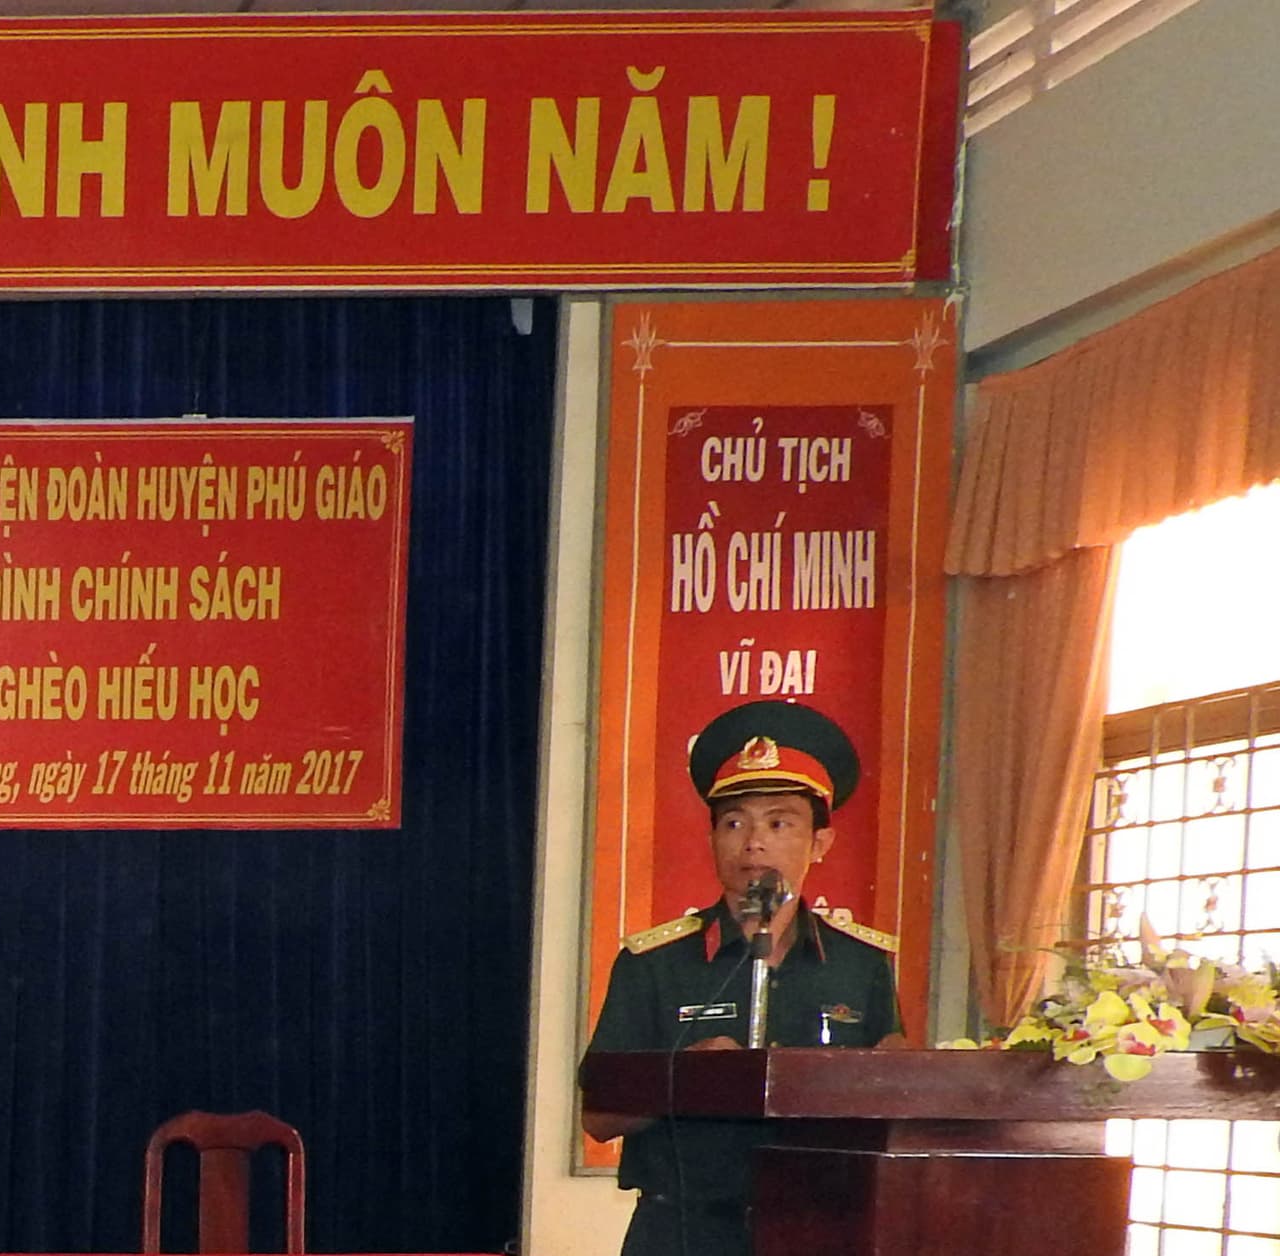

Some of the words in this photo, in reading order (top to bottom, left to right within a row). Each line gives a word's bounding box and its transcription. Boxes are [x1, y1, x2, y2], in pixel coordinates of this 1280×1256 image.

[168, 70, 486, 218] MUÔN
[526, 66, 770, 213] NĂM
[47, 452, 128, 521] ĐOÀN
[137, 454, 237, 537] HUYỆN
[247, 451, 306, 521] PHÚ
[316, 450, 387, 520] GIÁO
[702, 417, 766, 481] CHỦ
[778, 437, 851, 493] TỊCH
[71, 551, 178, 621] CHÍNH
[189, 551, 280, 621] SÁCH
[672, 501, 720, 612] HỒ
[728, 512, 785, 612] CHÍ
[793, 531, 875, 610] MINH
[98, 643, 178, 720] HIẾU
[189, 665, 259, 736] HỌC
[720, 638, 754, 694] VĨ
[760, 650, 816, 703] ĐẠI
[28, 751, 87, 803] ngày
[92, 751, 127, 794] 17
[130, 751, 198, 803] tháng
[203, 751, 234, 794] 11
[240, 754, 292, 794] năm
[295, 750, 363, 794] 2017
